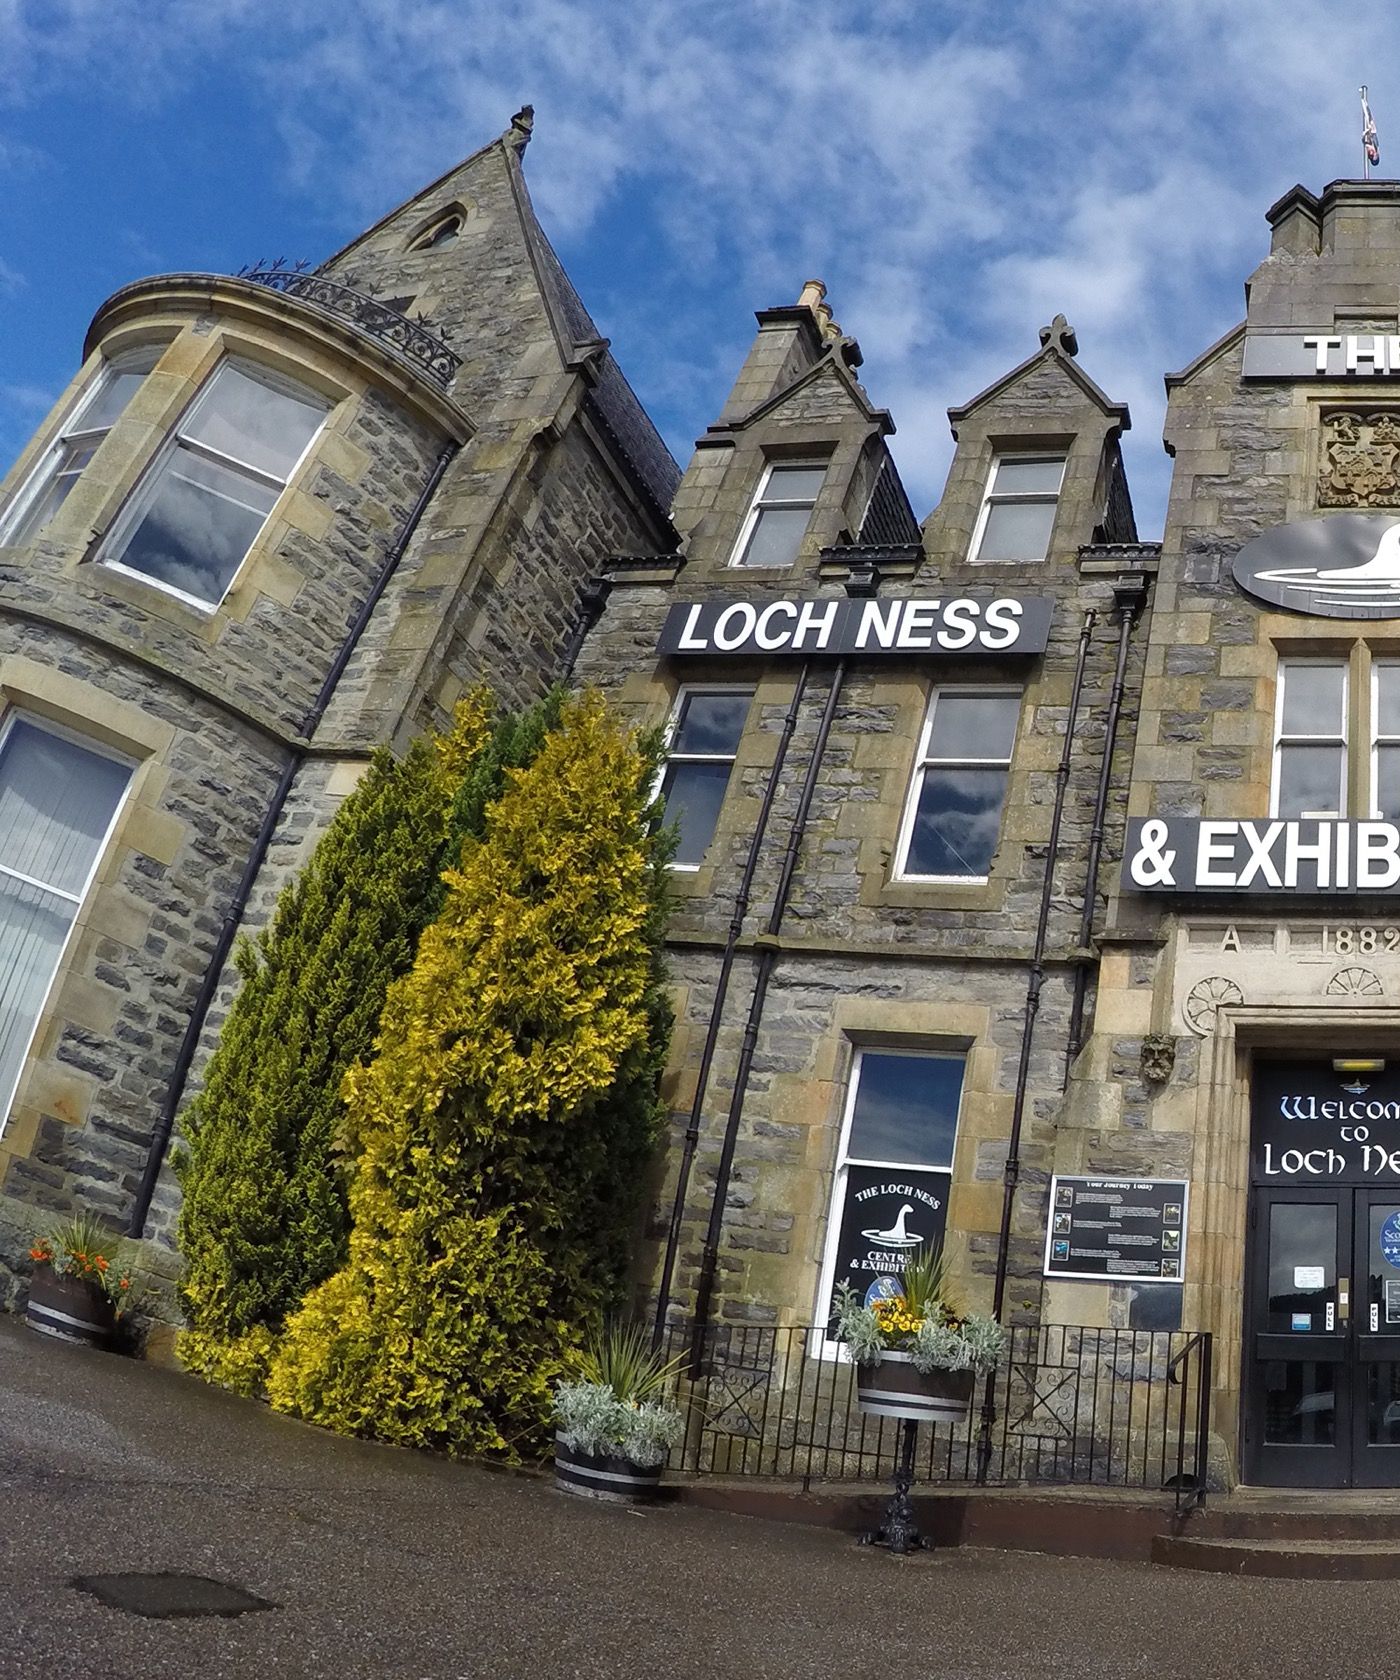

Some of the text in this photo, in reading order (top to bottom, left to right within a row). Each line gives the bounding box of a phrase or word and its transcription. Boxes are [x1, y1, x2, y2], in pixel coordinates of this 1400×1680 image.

[678, 598, 1024, 651] LOCH NESS
[1130, 819, 1177, 886] &
[1220, 925, 1242, 953] A
[1321, 926, 1400, 955] 1882
[1340, 1126, 1369, 1142] to
[1263, 1143, 1346, 1176] Loch
[855, 1184, 941, 1210] THE LOCH NESS
[850, 1259, 860, 1269] &
